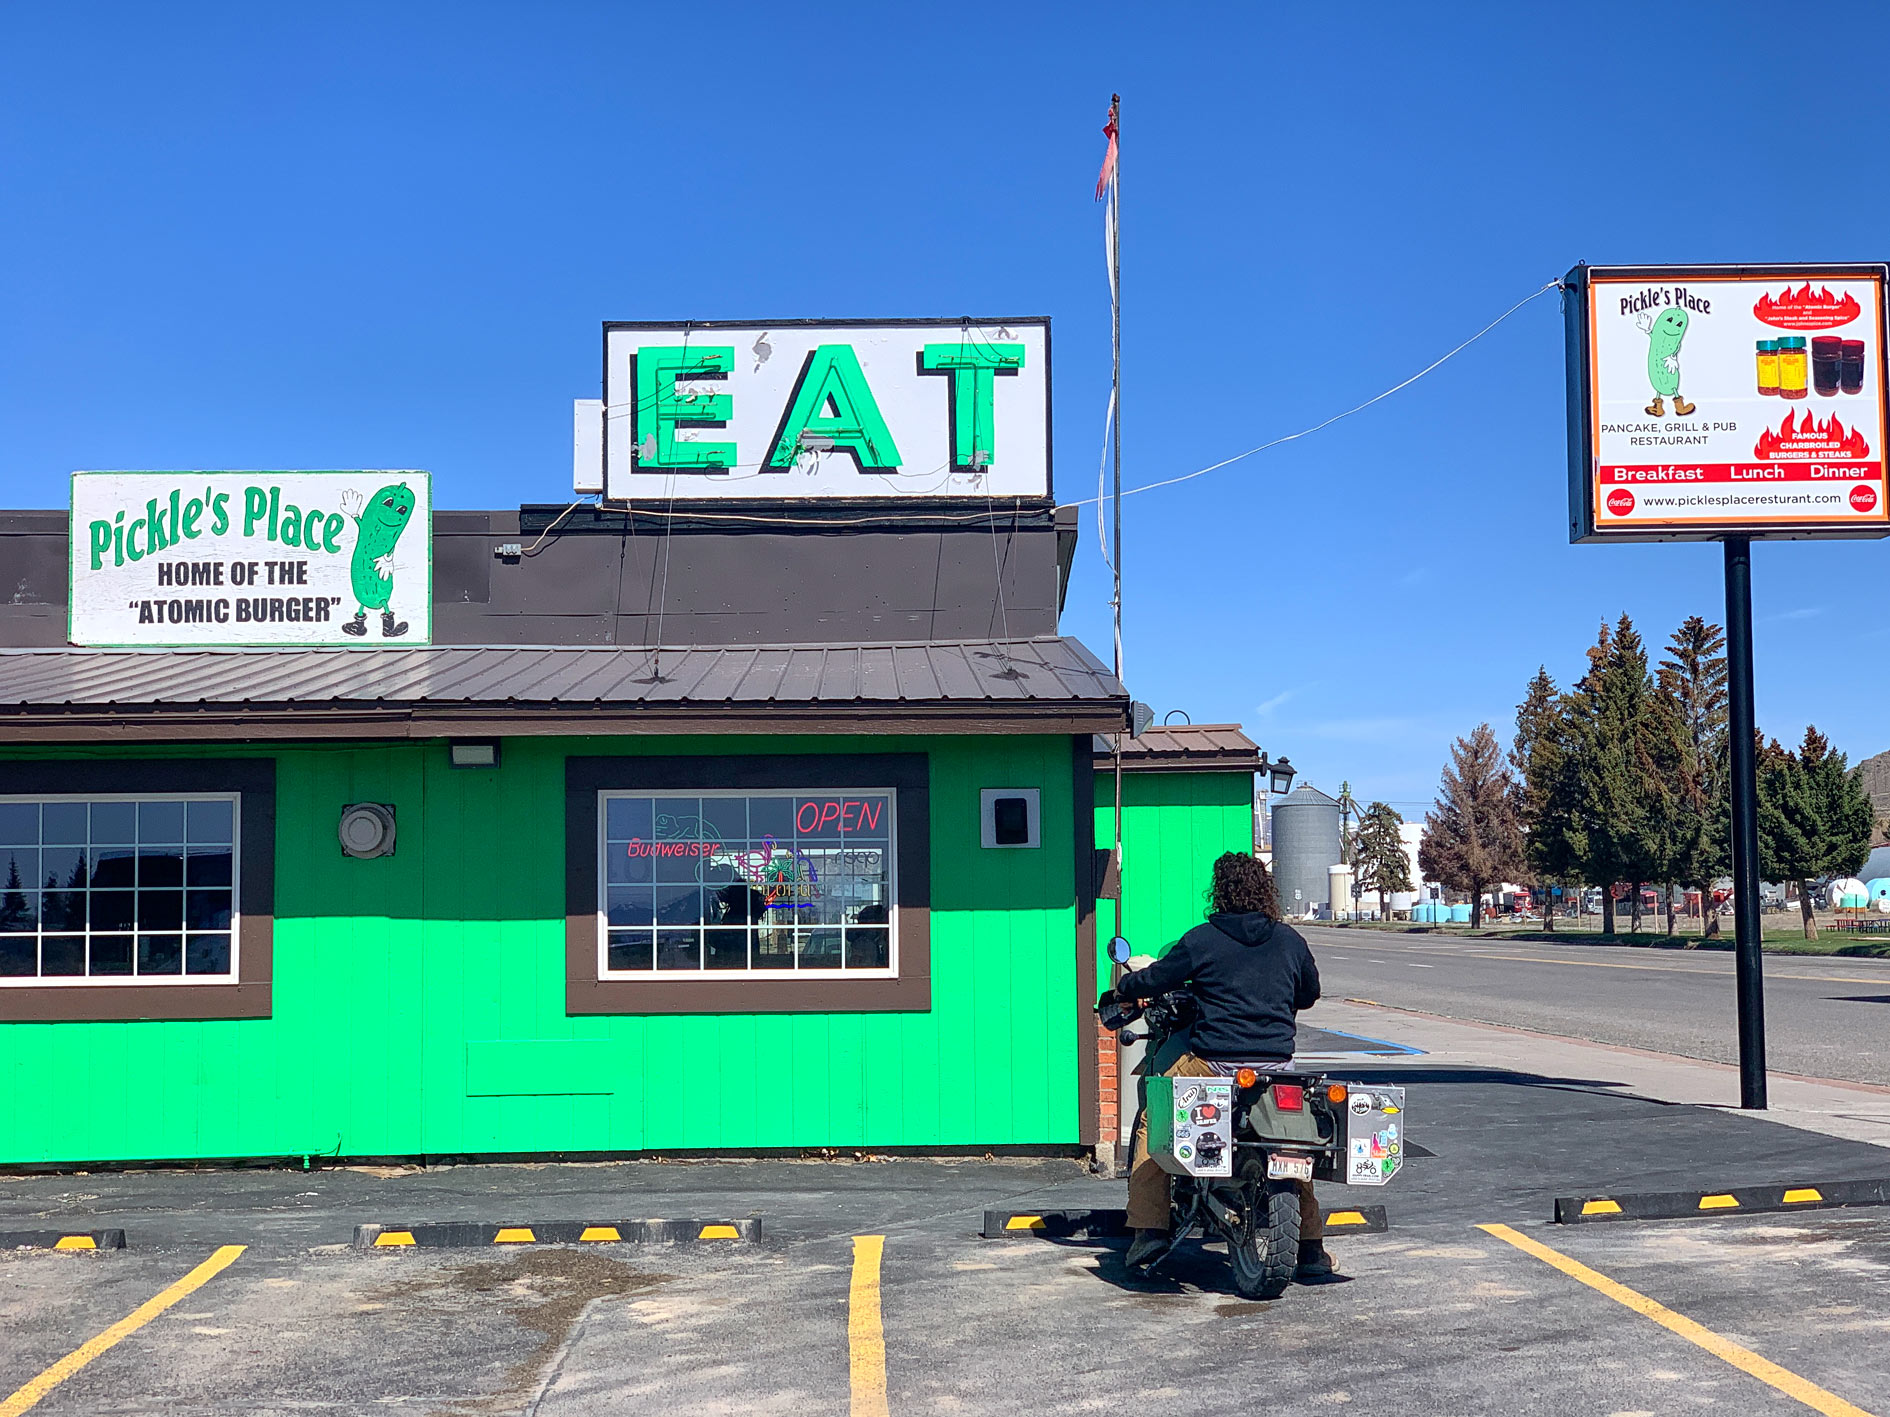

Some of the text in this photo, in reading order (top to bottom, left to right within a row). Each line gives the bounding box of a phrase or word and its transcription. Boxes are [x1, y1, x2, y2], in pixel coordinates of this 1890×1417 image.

[1620, 287, 1711, 315] Pickle's Place
[631, 343, 1026, 474] EAT
[1601, 422, 1737, 433] PANCAKE, GRILL & PUB
[1630, 435, 1709, 446] RESTAURANT
[1614, 464, 1868, 481] Breakfast Lunch Dinner
[1643, 494, 1841, 507] www.picklesplaceresturant.com
[89, 486, 345, 570] Pickle's Place
[158, 561, 308, 586] HOME OF THE
[797, 801, 882, 833] OPEN
[627, 838, 720, 857] Budweiser
[1194, 1107, 1203, 1120] I
